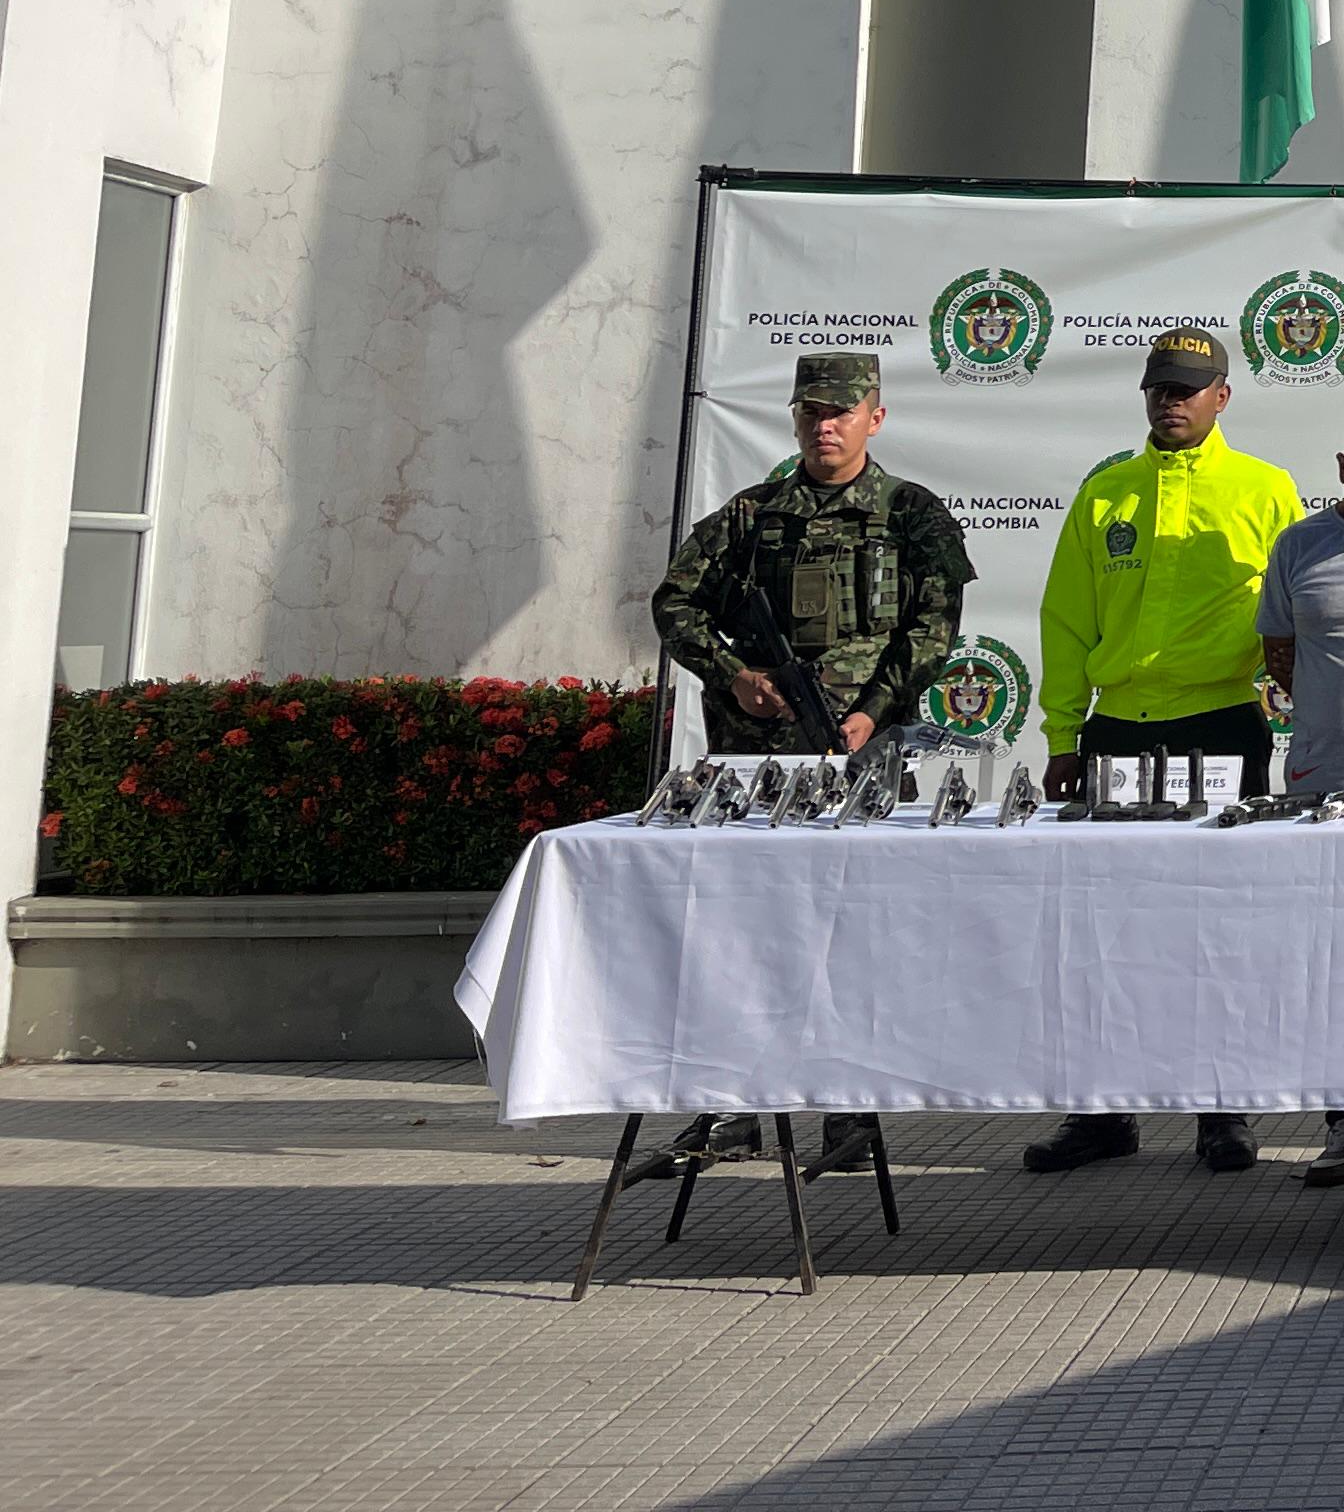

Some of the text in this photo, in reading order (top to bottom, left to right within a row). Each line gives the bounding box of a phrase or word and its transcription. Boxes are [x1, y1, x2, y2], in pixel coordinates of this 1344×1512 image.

[749, 310, 919, 327] POLICÍA NACIONAL
[1063, 313, 1230, 328] POLICÍA NACIONAL
[770, 332, 894, 346] DE COLOMBIA
[1084, 334, 1107, 346] DE
[987, 369, 1020, 384] PATRIA
[1299, 370, 1331, 384] PATRIA
[970, 497, 1064, 510] NACIONAL
[959, 517, 1040, 529] OLOMBIA
[965, 649, 1017, 704] DE COLOMBIA
